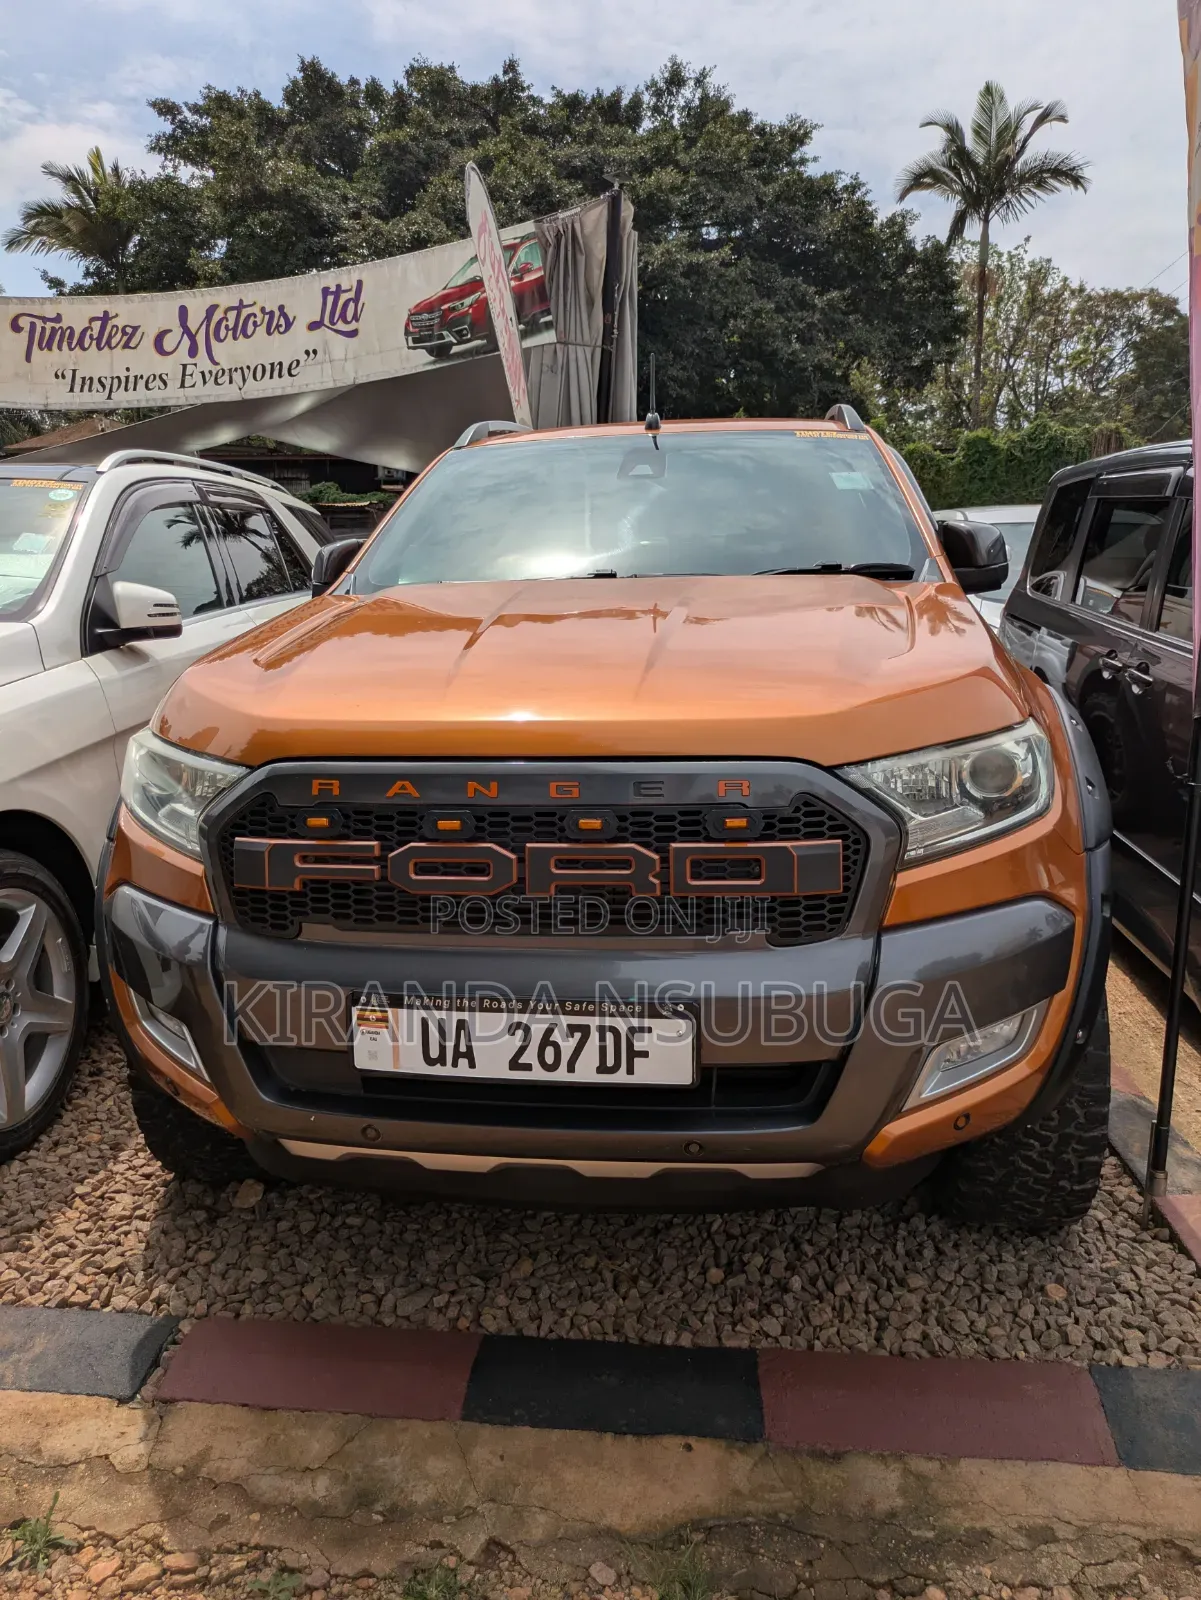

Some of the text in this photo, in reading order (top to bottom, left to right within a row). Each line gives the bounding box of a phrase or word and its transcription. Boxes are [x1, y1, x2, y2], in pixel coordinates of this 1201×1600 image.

[10, 278, 365, 366] Timotez Motors Ltd
[311, 779, 752, 799] RANGER
[233, 836, 843, 898] FORD
[404, 995, 642, 1013] Making the Roads Your Safe Space
[421, 1016, 653, 1076] UA 267DF
